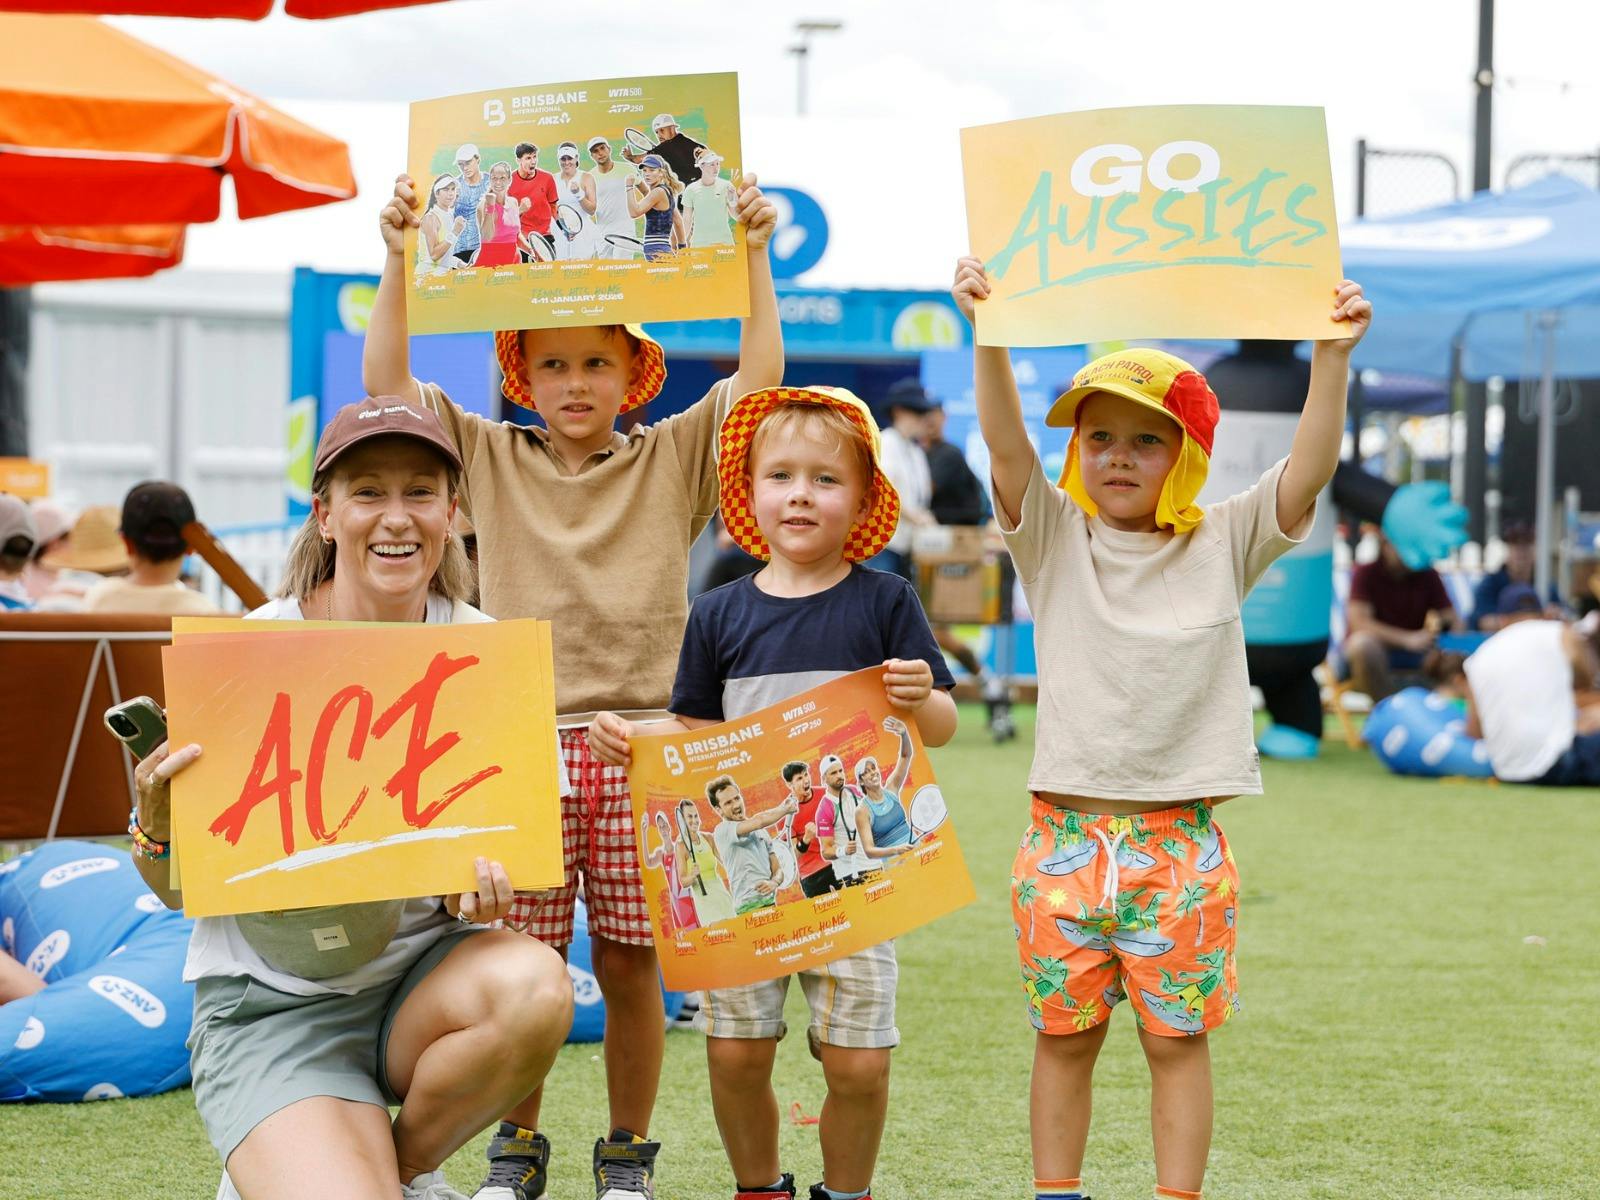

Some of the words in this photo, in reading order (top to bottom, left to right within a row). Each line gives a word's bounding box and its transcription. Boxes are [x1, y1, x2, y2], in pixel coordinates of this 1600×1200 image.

[511, 91, 588, 109] BRISBANE
[511, 105, 562, 116] INTERNATIONAL
[537, 116, 560, 126] ANZ
[1069, 140, 1221, 197] GO
[550, 294, 596, 304] JANUARY
[1116, 360, 1155, 385] PATROL
[683, 722, 764, 756] BRISBANE
[207, 651, 503, 857] ACE
[687, 746, 739, 763] INTERNATIONAL
[716, 756, 741, 772] ANZ
[752, 934, 786, 949] TENNIS
[774, 931, 822, 952] JANUARY
